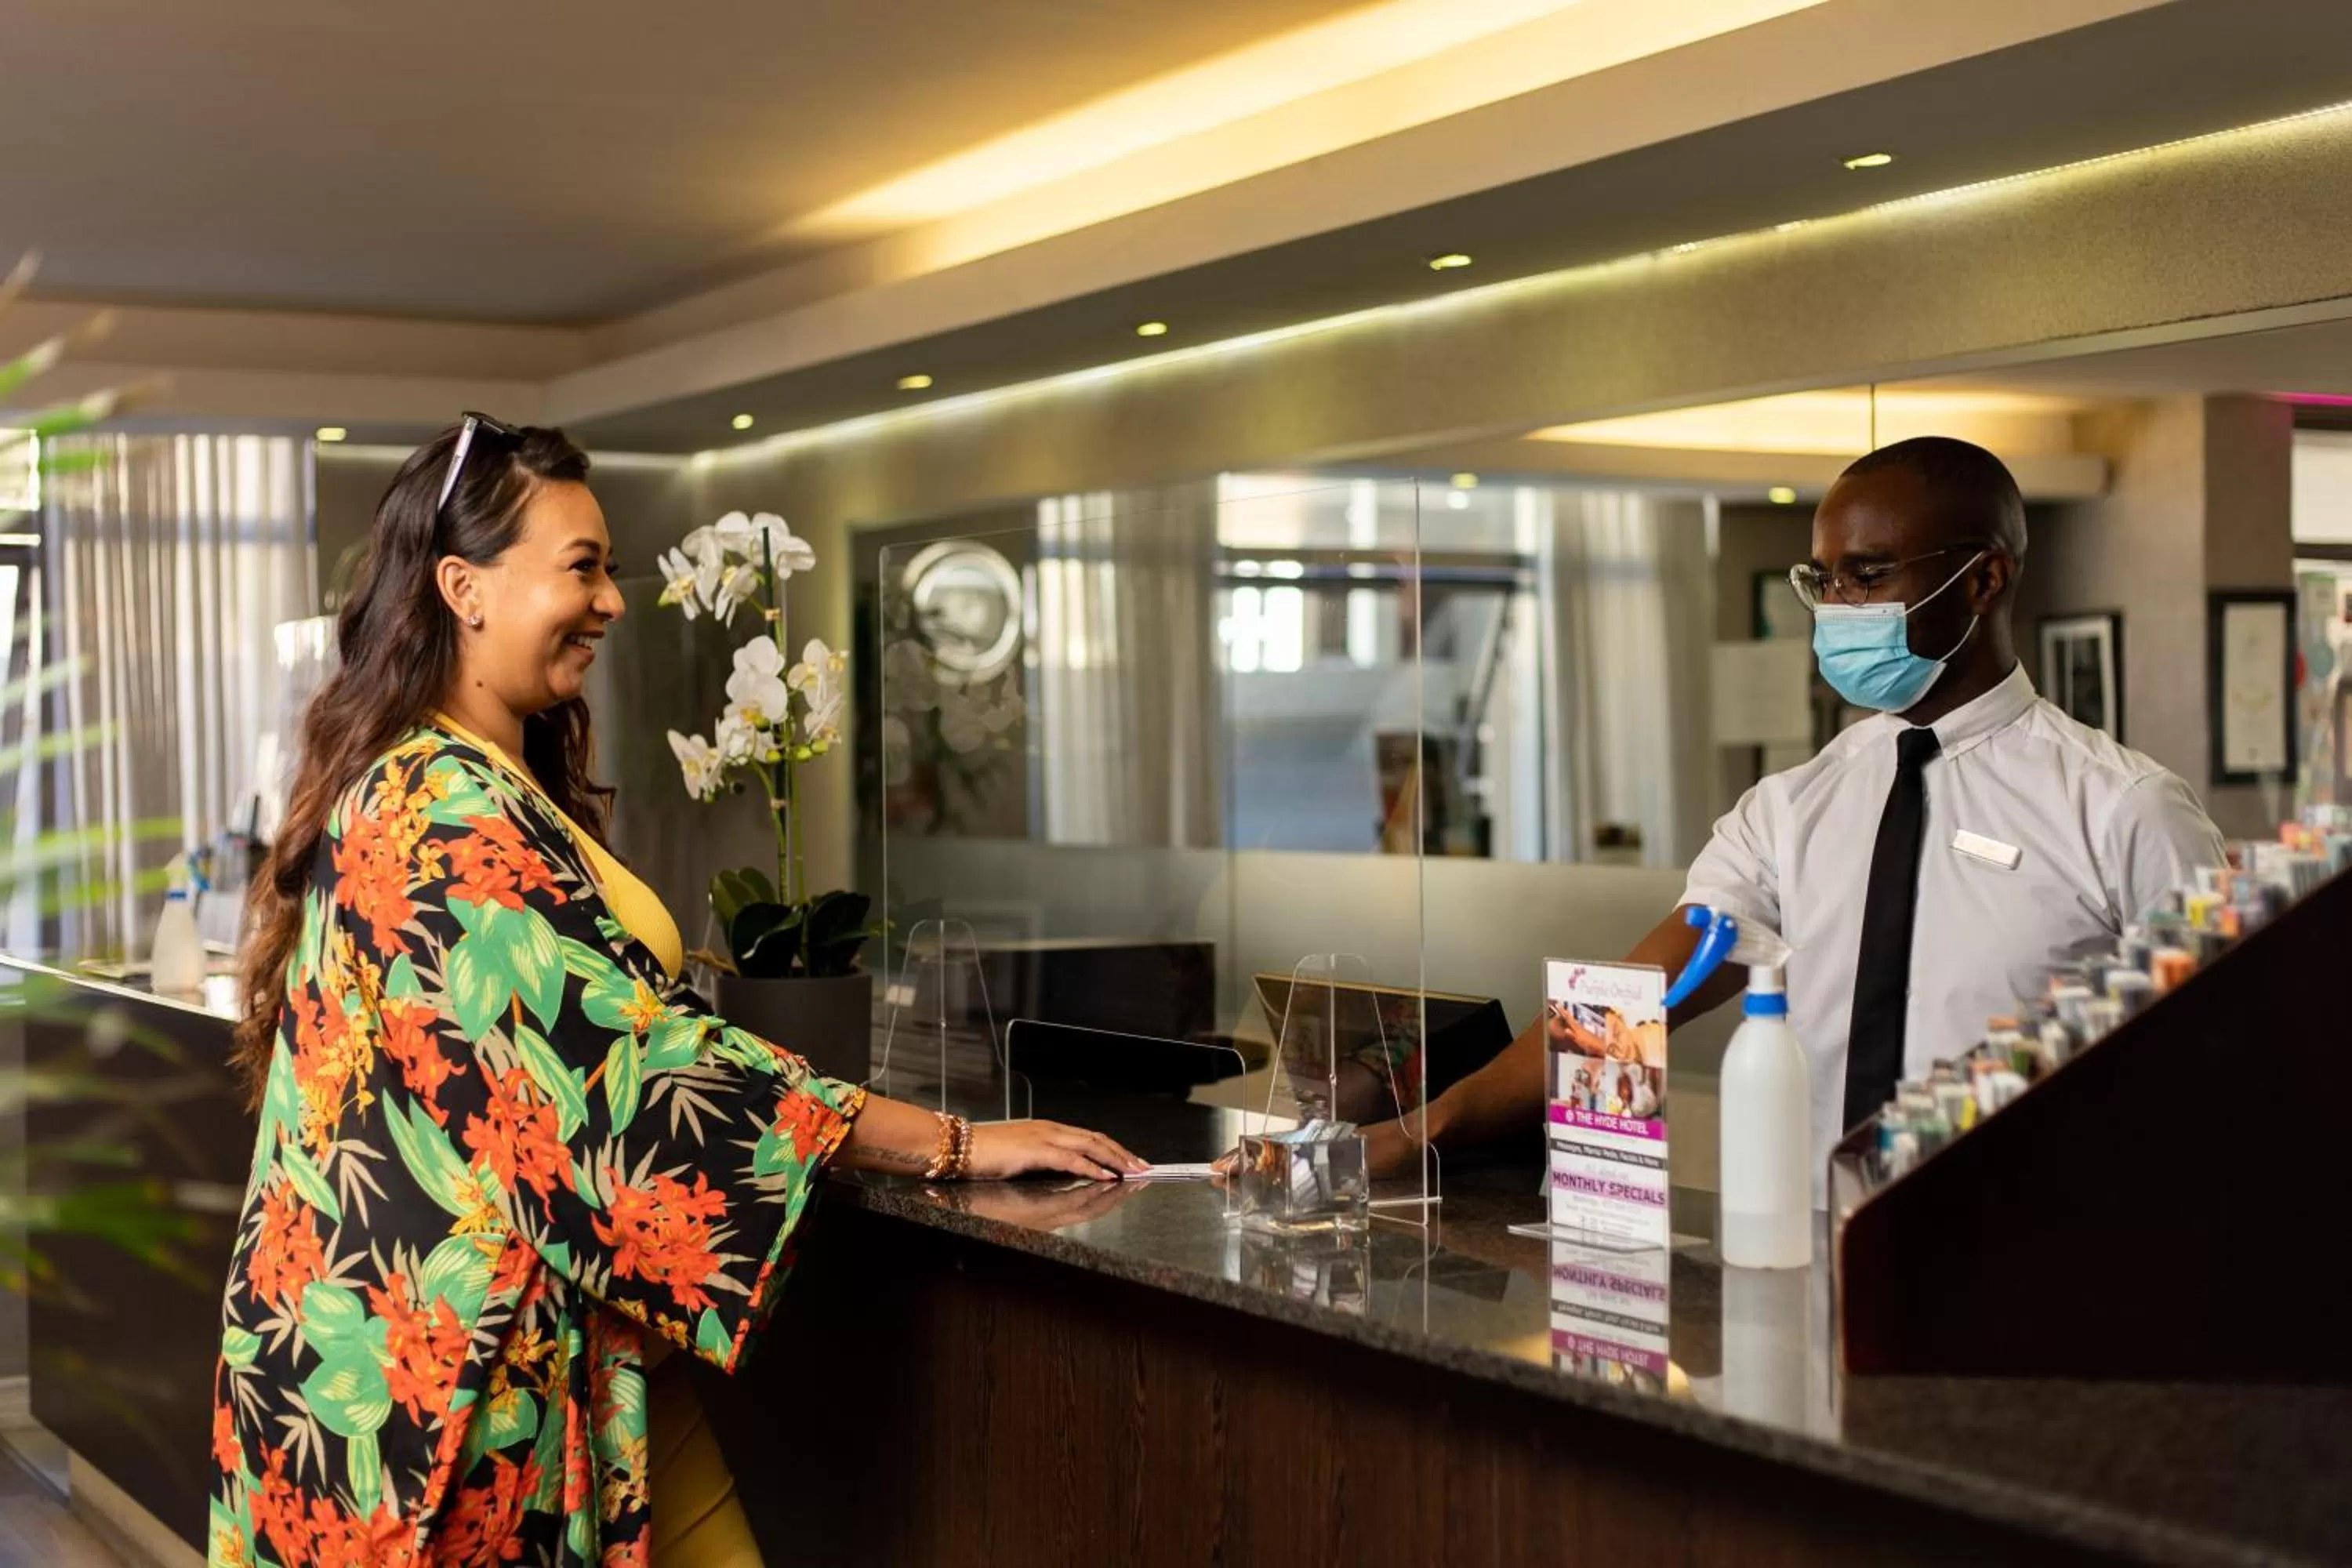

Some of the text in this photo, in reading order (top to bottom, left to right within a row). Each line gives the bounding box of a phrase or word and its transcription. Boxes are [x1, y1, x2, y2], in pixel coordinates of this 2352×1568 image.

[1576, 1111, 1594, 1125] THE
[1595, 1114, 1618, 1129] HYDE
[1619, 1119, 1650, 1135] HOTEL
[1552, 1171, 1606, 1192] MONTHLY
[1608, 1181, 1665, 1205] SPECIALS
